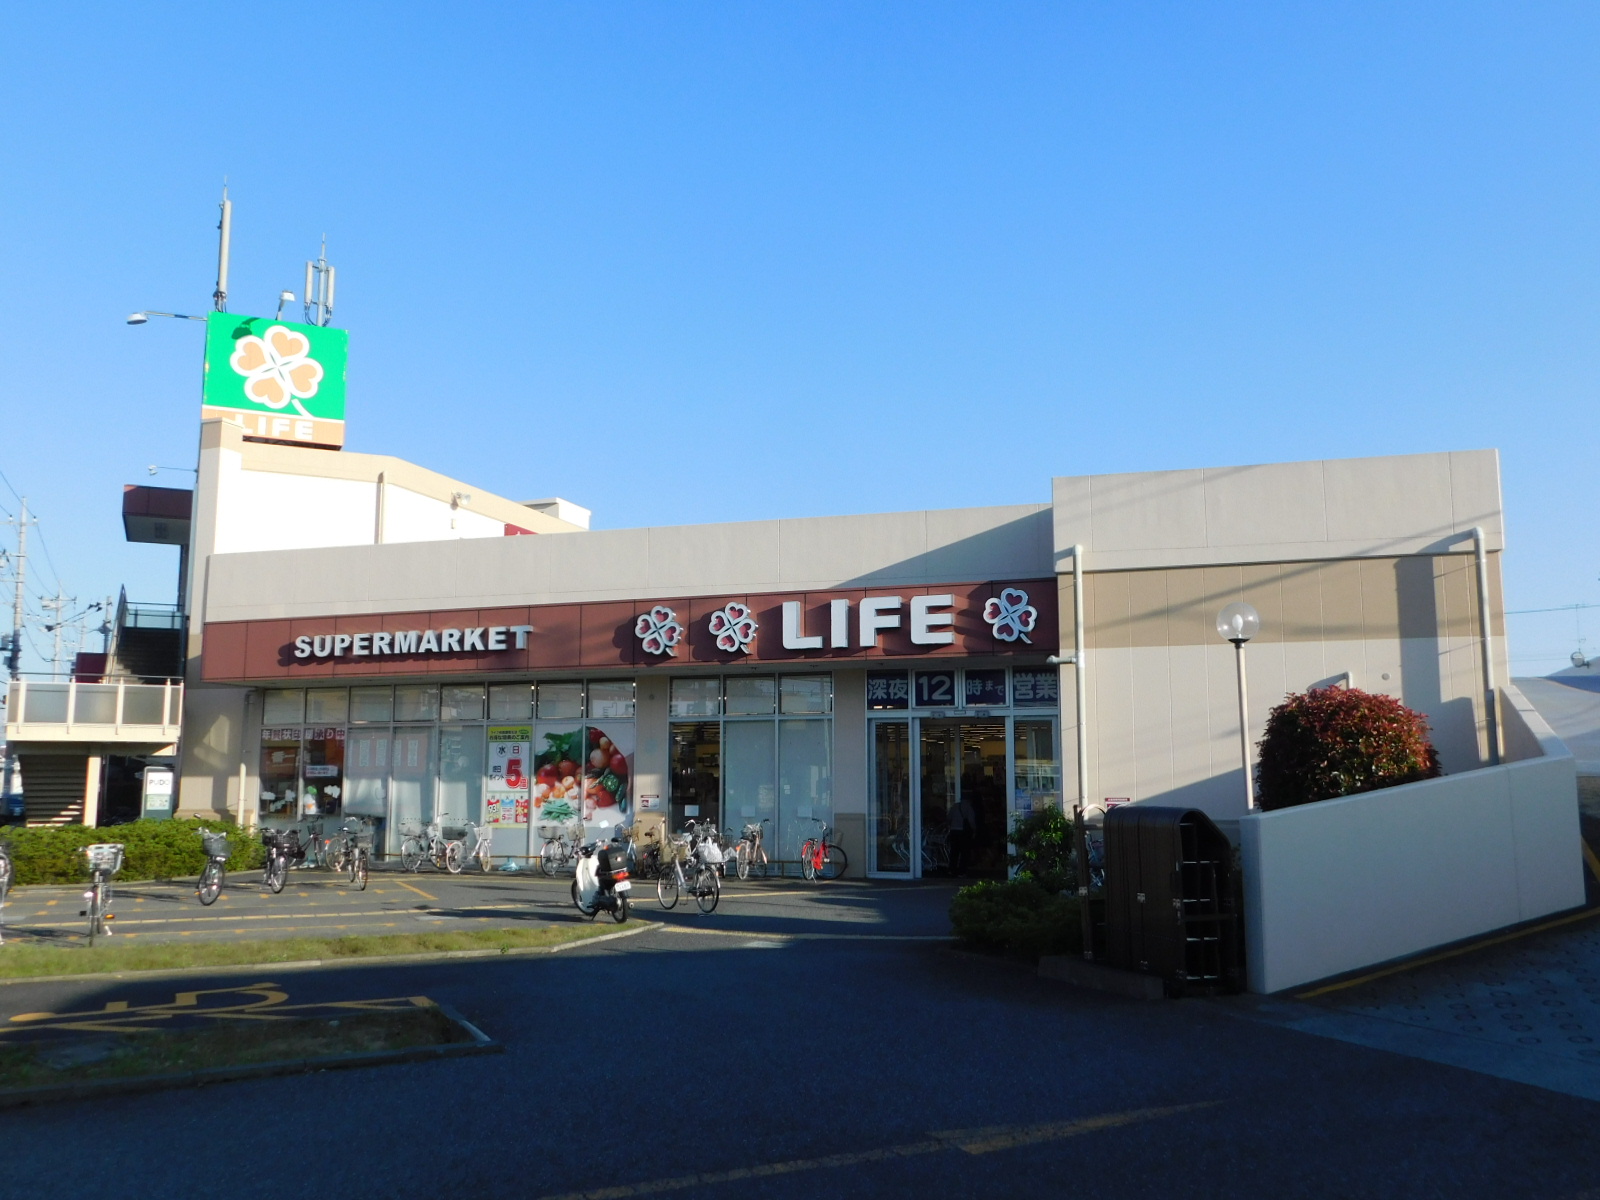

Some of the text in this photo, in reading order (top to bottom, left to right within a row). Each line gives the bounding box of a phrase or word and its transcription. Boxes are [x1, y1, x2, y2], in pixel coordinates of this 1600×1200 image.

[782, 594, 955, 650] LIFE
[294, 625, 533, 658] SUPERMARKET
[512, 745, 520, 754] 日
